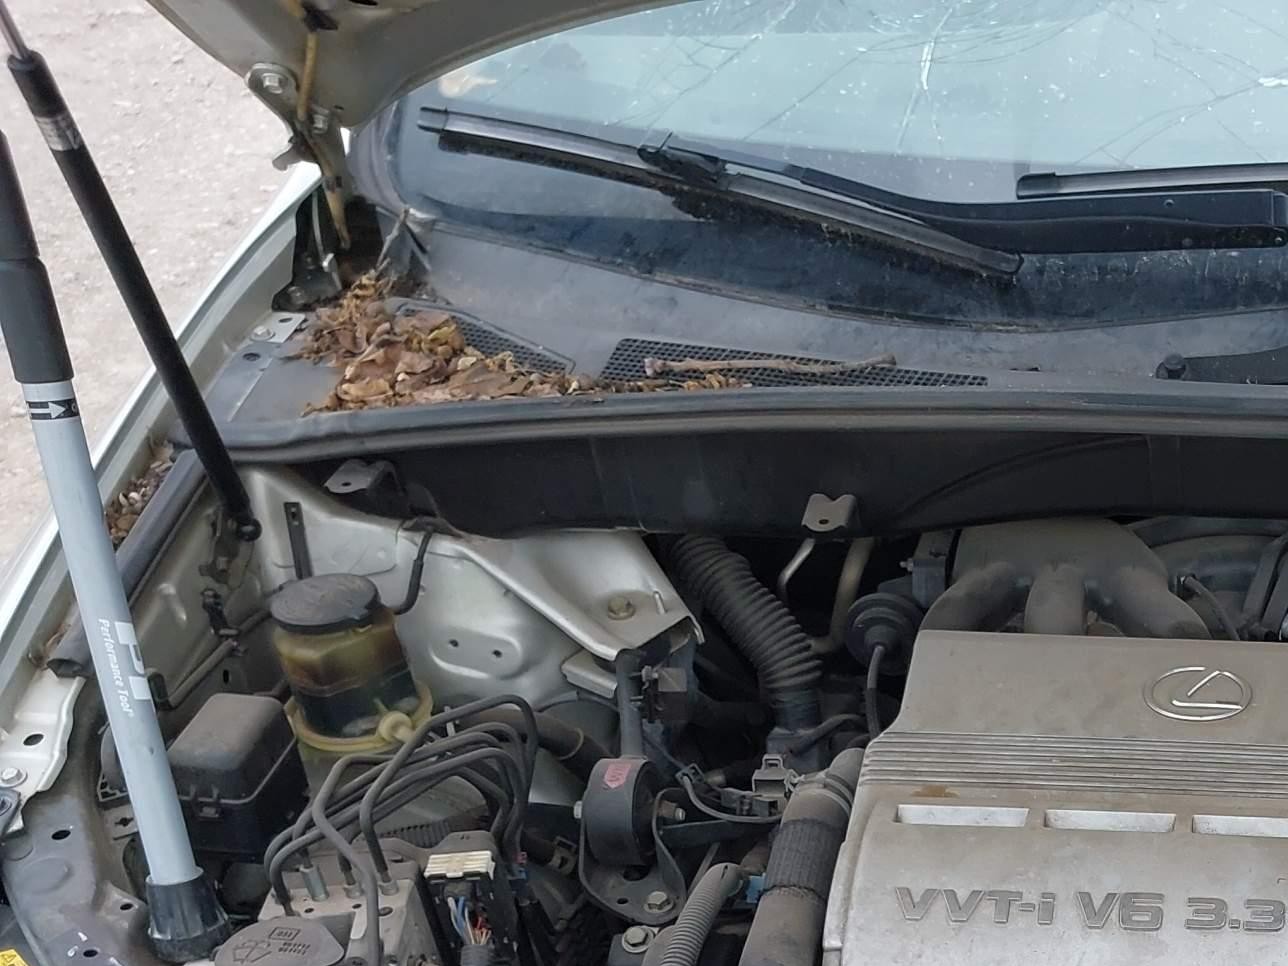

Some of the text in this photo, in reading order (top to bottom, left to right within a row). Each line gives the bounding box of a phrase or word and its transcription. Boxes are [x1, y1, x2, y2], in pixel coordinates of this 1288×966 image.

[98, 618, 133, 713] Performance Tool
[895, 886, 1287, 933] VVT-i V6 3.3
